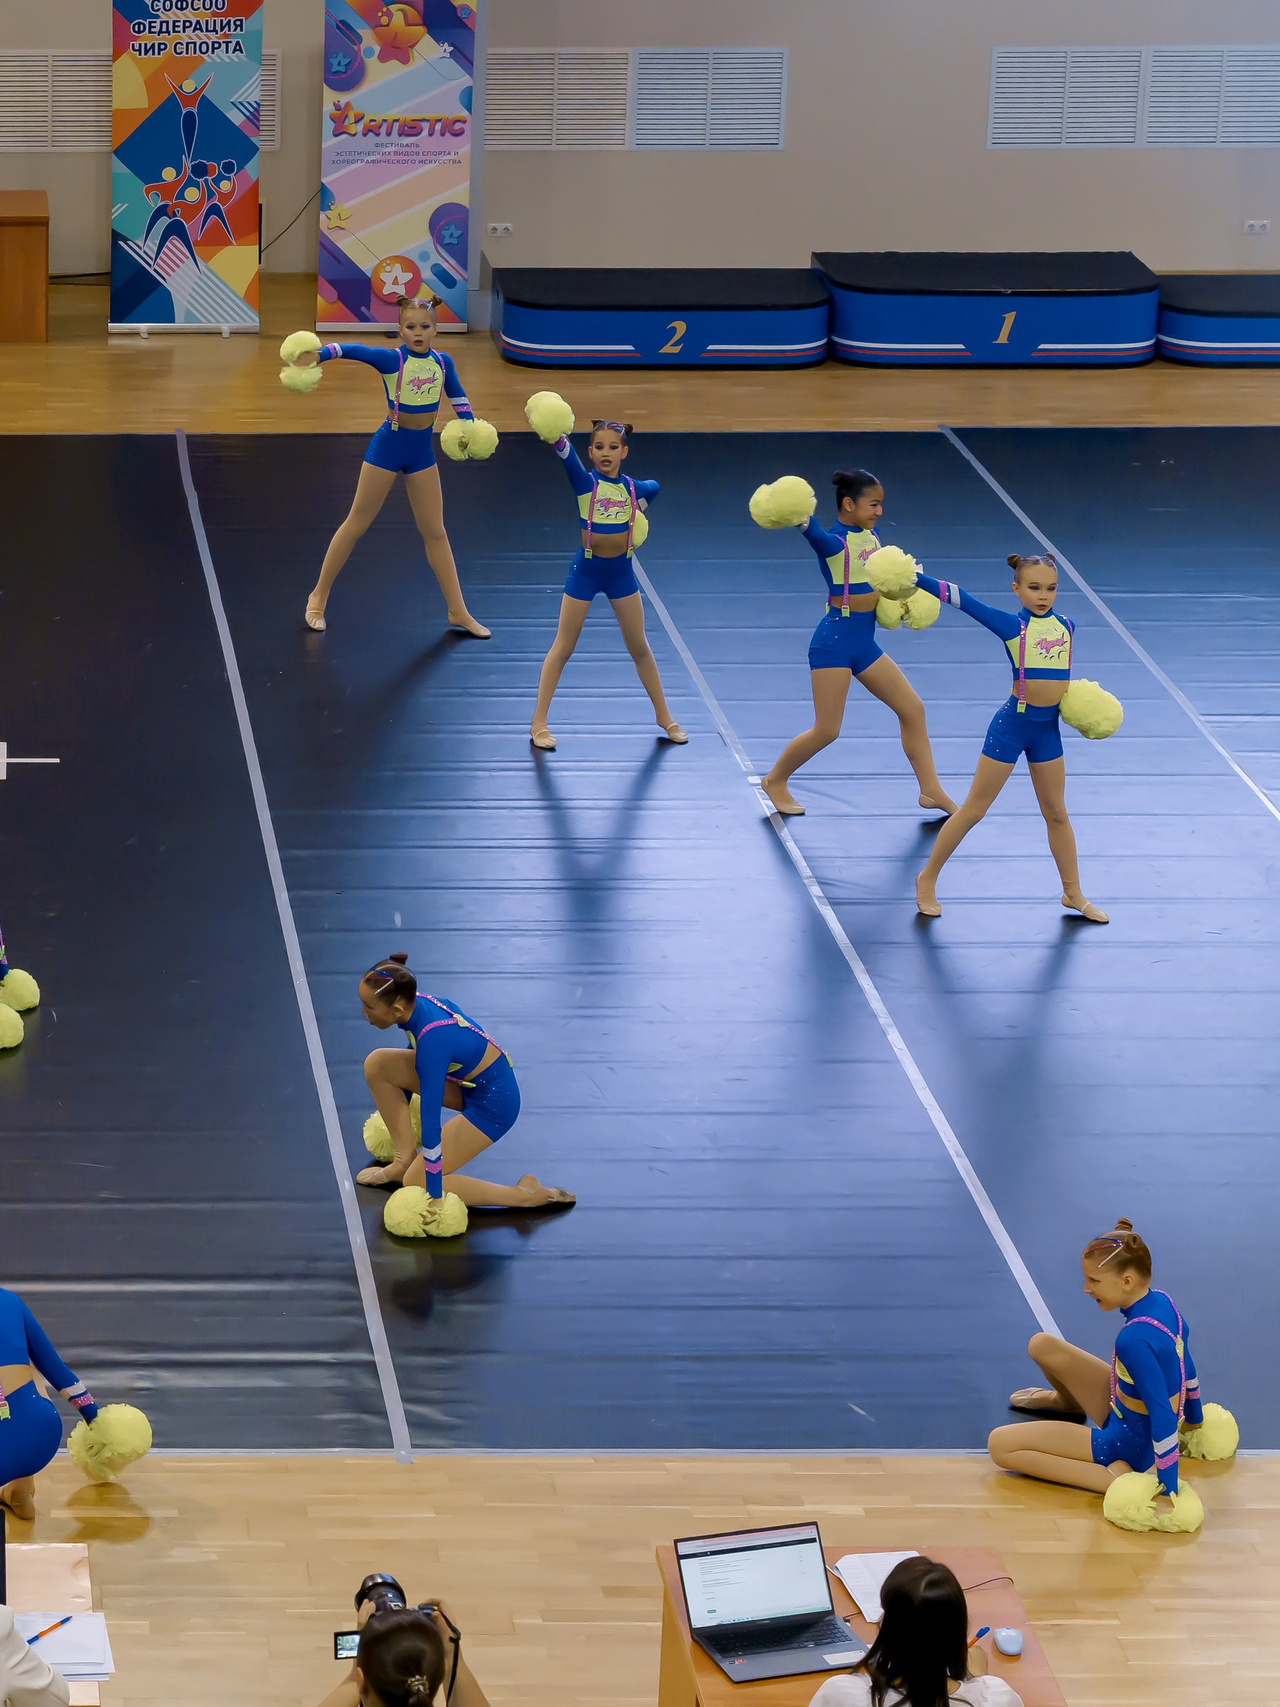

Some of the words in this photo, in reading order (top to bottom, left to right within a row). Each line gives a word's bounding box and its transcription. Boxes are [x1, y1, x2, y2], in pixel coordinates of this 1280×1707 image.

[131, 18, 245, 36] ФЕДЕРАЦИЯ
[131, 42, 169, 57] ЧИР
[172, 40, 245, 55] СПОРТА
[331, 158, 417, 166] ХОРЕОГРАФИЧЕСКОГО
[658, 320, 687, 353] 2
[992, 311, 1017, 344] 1
